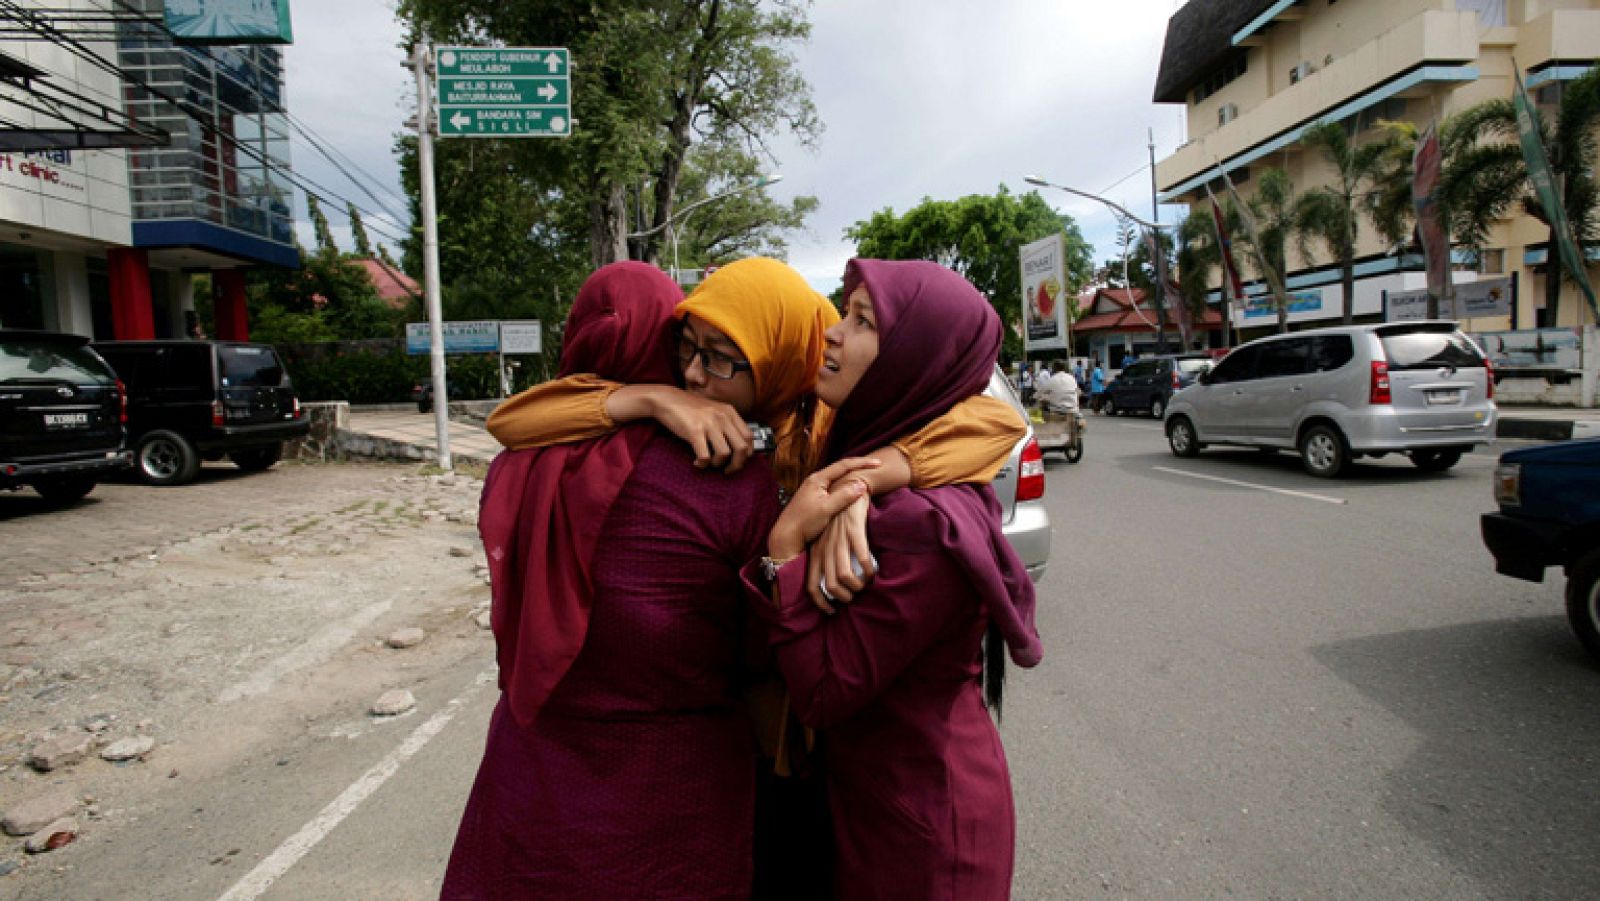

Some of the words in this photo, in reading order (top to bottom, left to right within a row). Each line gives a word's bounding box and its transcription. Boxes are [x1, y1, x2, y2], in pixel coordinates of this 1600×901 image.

[460, 63, 511, 73] MEULABOH
[489, 81, 515, 91] RAYA
[448, 92, 522, 103] BAITURRAHMAN
[477, 110, 521, 120] BANDARA
[19, 161, 59, 184] clinic
